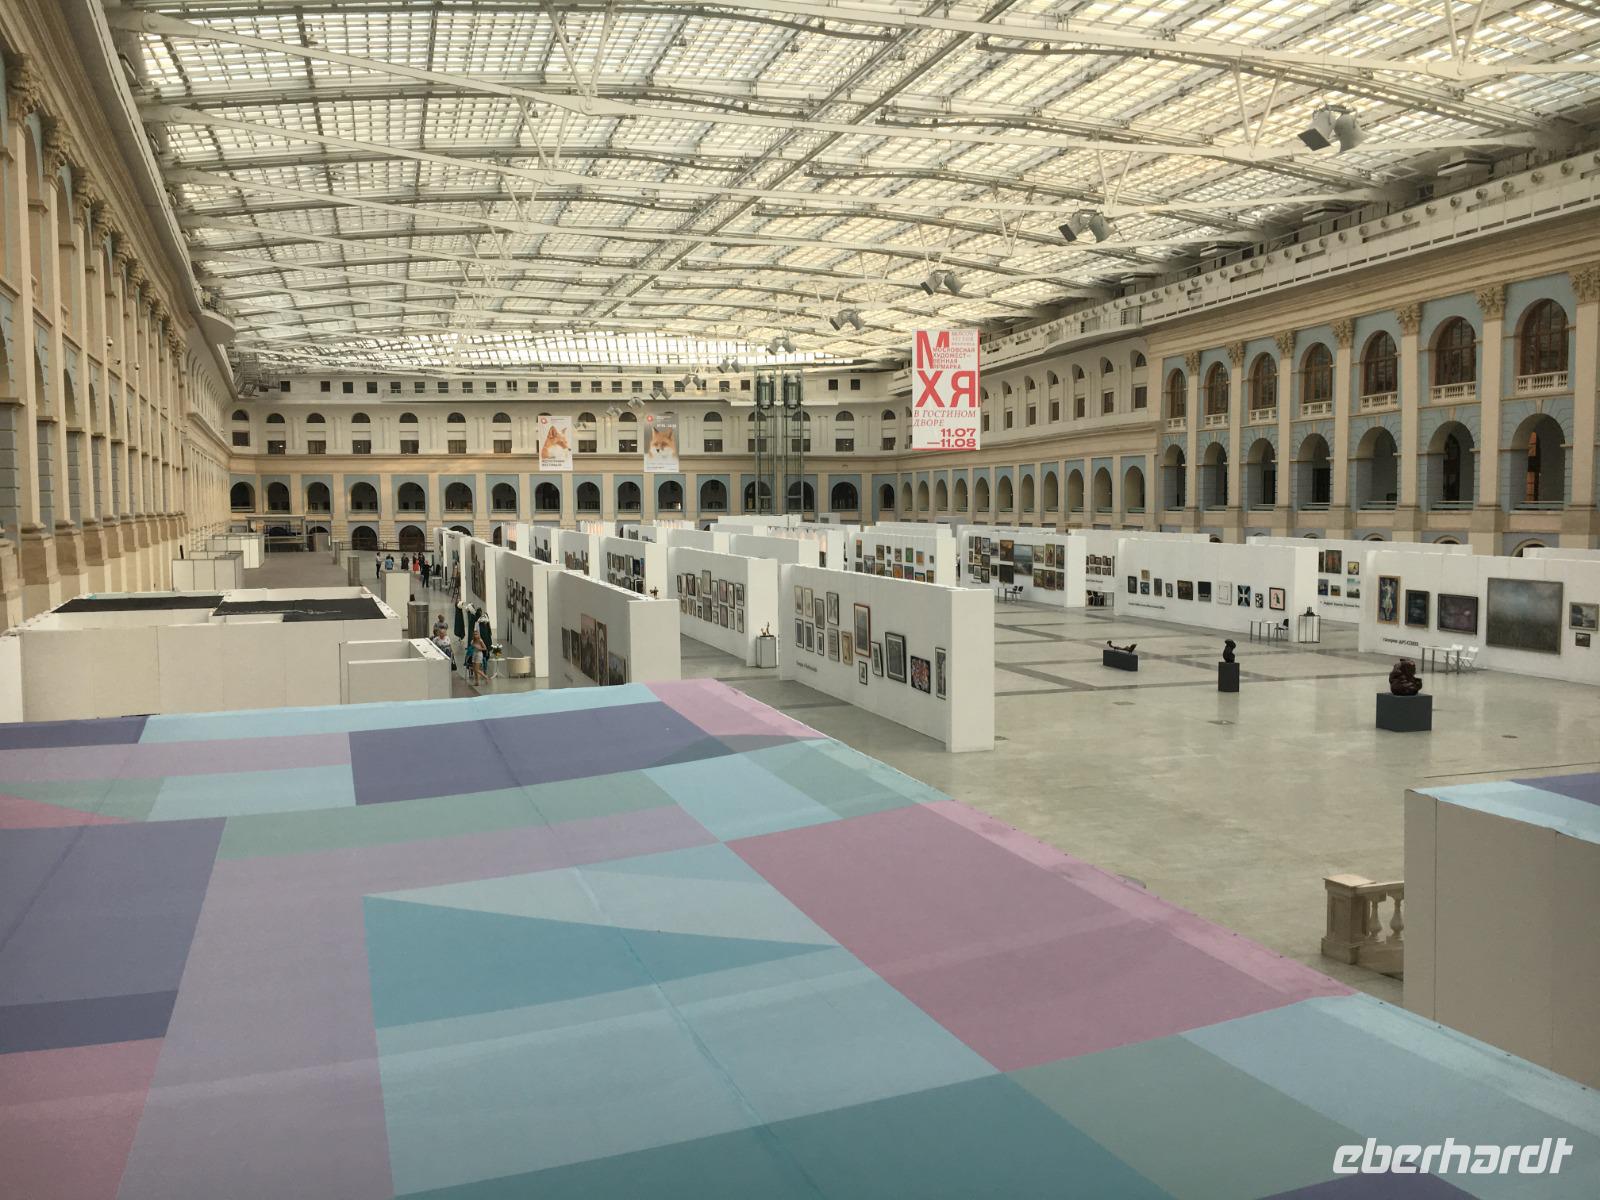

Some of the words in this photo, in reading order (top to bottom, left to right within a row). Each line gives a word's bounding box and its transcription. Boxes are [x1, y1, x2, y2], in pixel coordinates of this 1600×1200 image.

[914, 409, 920, 418] В
[922, 409, 976, 418] ГОСТИНОМ
[913, 419, 945, 427] ДВОРЕ
[940, 428, 977, 438] 11.07
